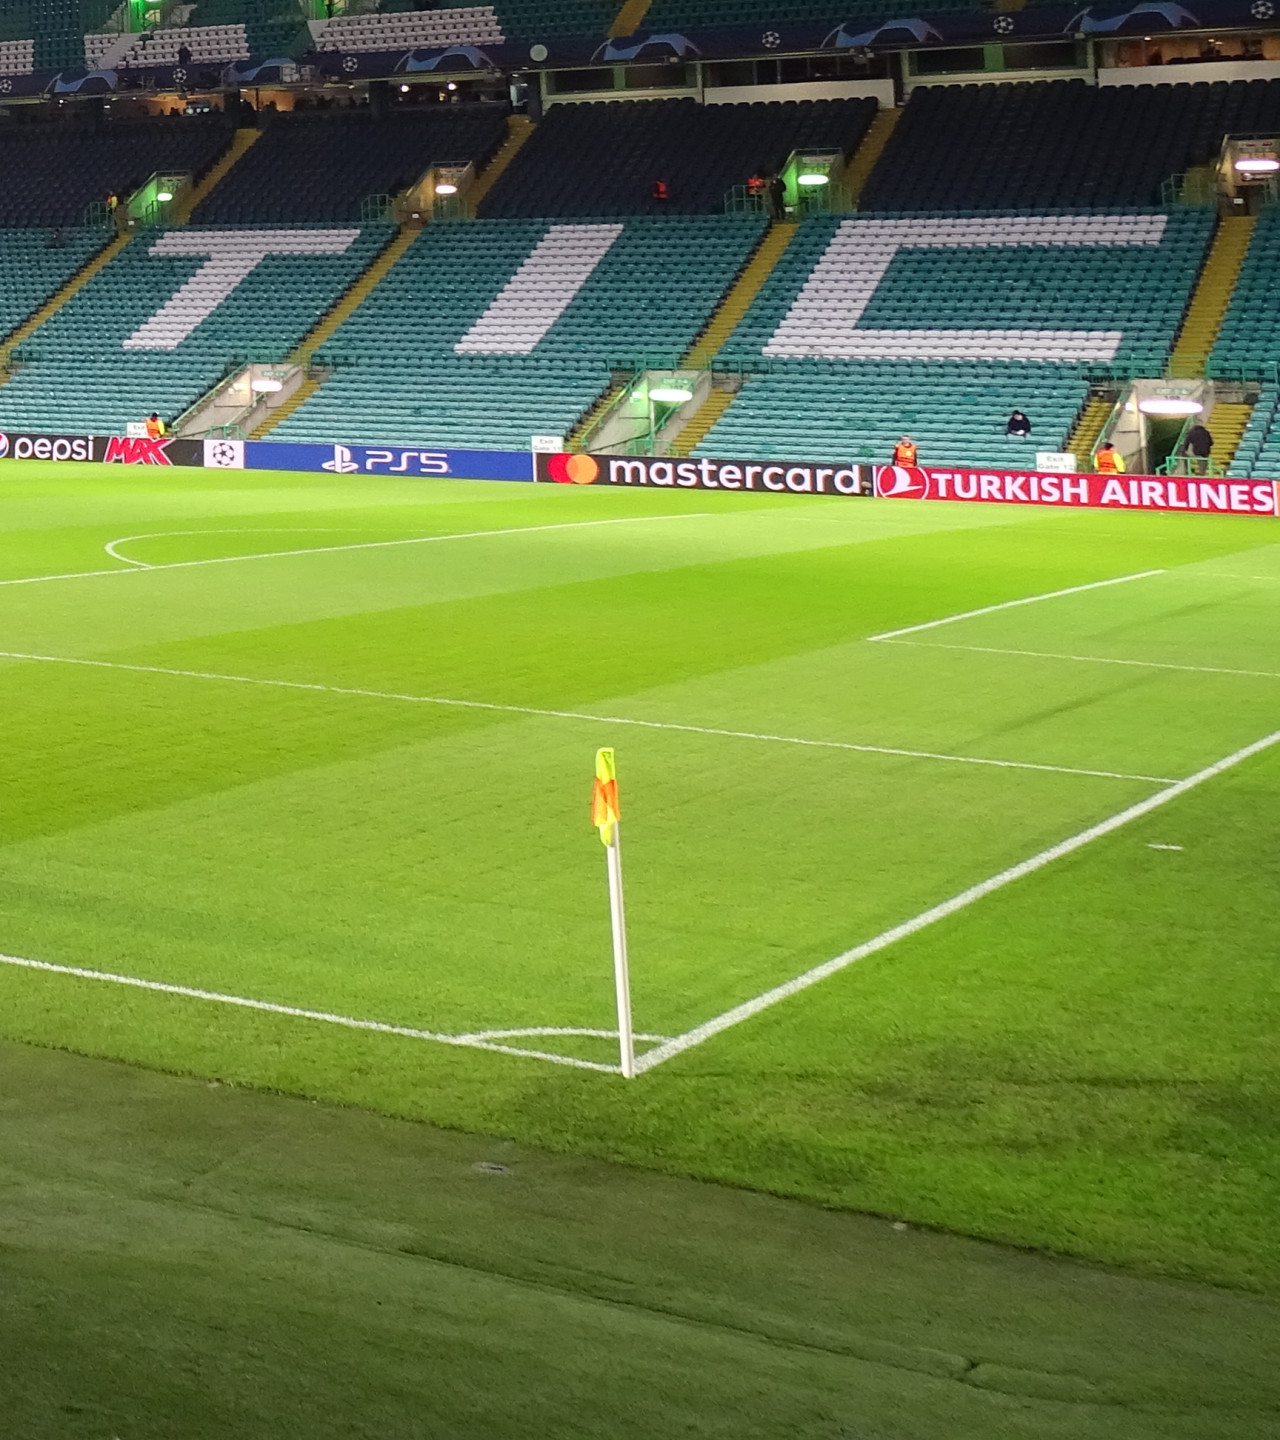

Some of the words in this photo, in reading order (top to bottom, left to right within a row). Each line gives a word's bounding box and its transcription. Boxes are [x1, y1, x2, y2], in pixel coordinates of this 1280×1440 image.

[14, 434, 93, 461] pepsi
[103, 436, 176, 465] MAX
[365, 450, 449, 473] PS5
[609, 458, 861, 494] mastercard
[932, 473, 1088, 504] TURKISH
[1101, 480, 1274, 512] AIRLINES
